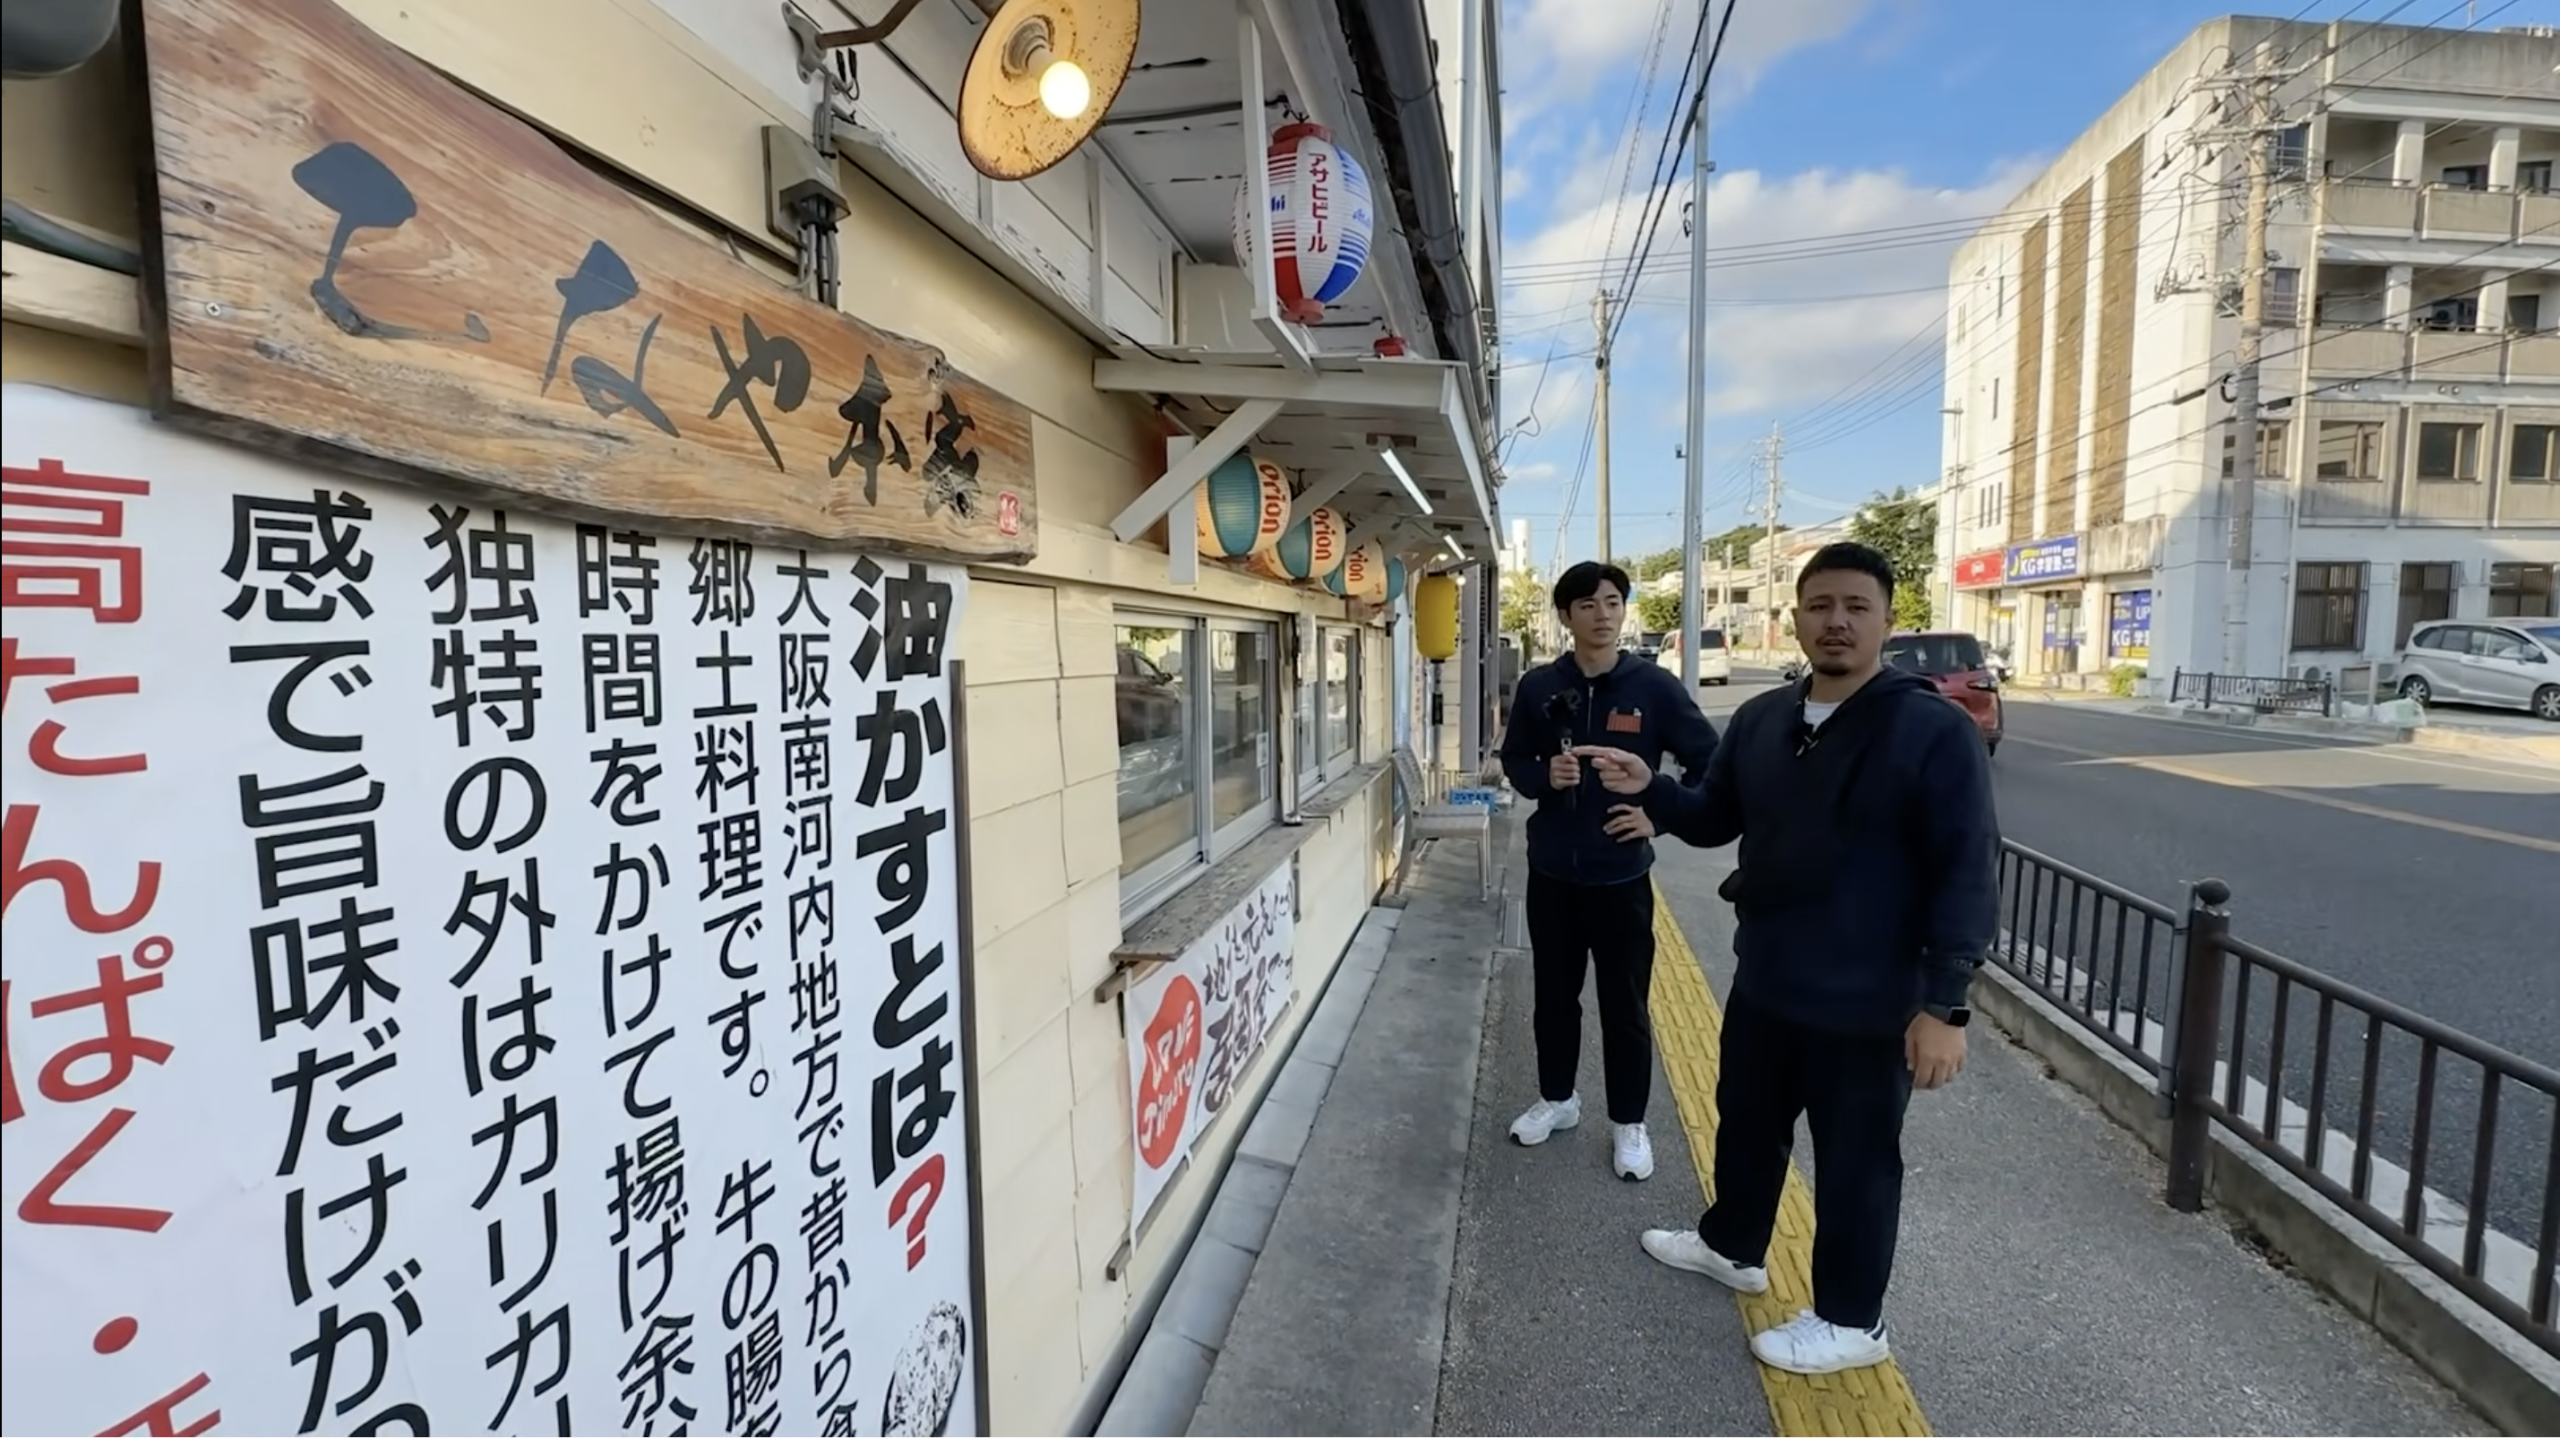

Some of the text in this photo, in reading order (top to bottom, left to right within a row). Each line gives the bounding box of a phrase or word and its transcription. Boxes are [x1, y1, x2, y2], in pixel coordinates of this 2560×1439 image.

[1308, 152, 1329, 254] アサヒビール
[1349, 544, 1369, 583] rion
[688, 536, 769, 1098] 郷土料理です。
[1145, 1000, 1195, 1091] LOVE
